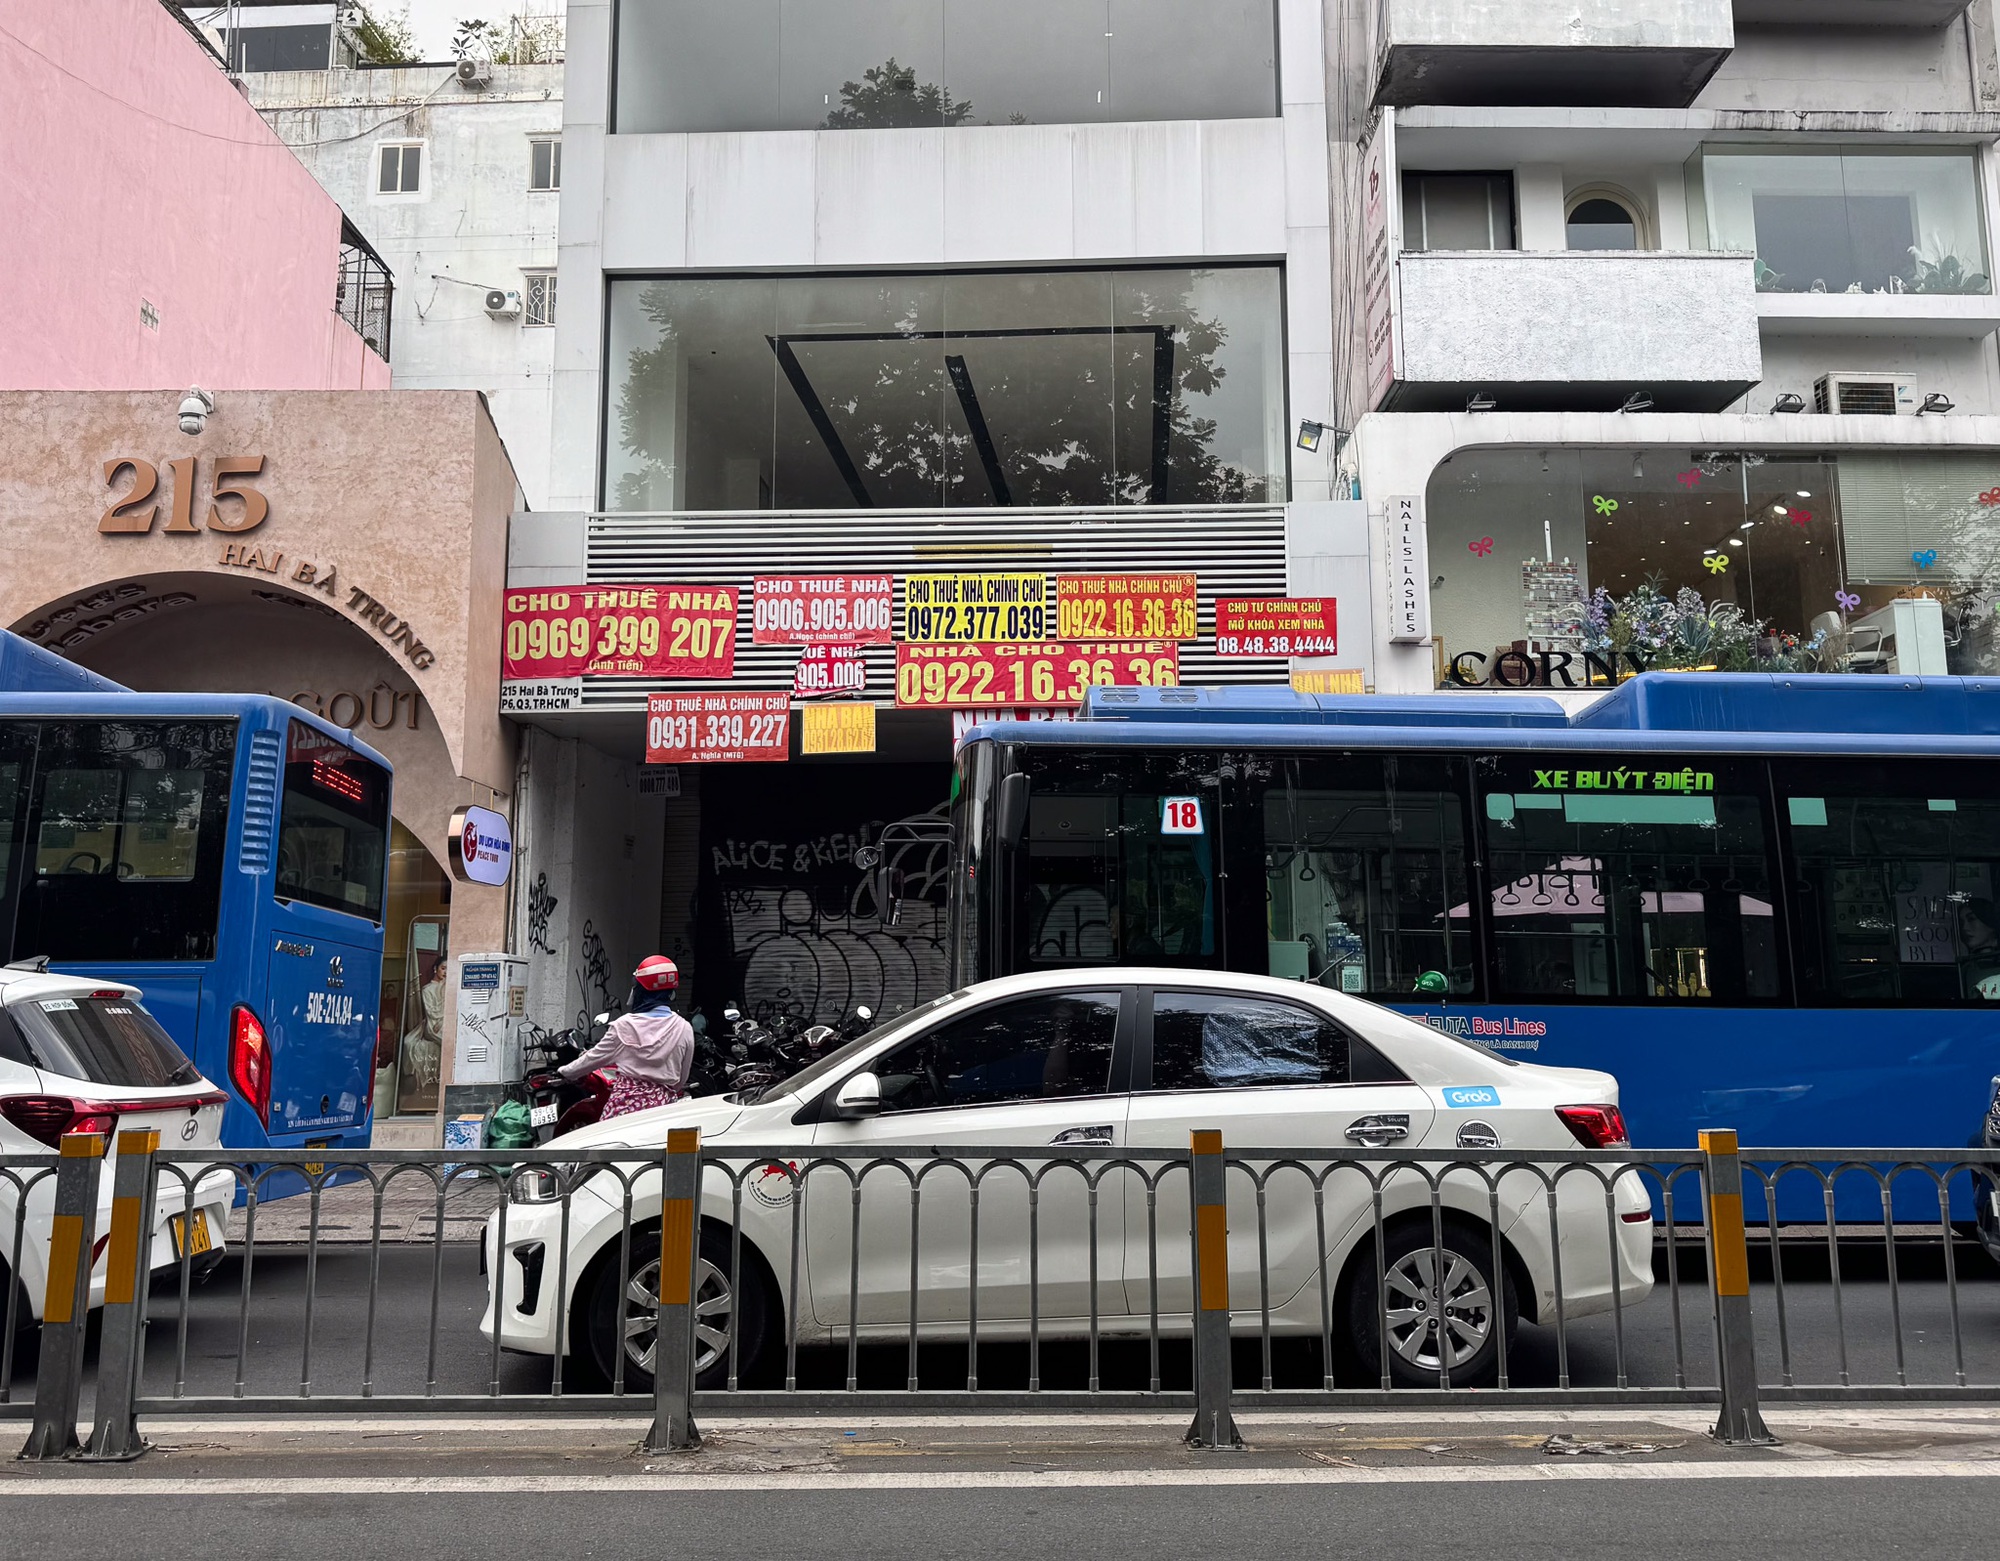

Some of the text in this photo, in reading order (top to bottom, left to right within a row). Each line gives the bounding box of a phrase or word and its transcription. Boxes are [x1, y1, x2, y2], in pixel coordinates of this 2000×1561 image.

[97, 455, 269, 536] 215
[756, 576, 890, 594] CHO THUÊ NHÀ
[909, 576, 1043, 602] CHO THUÊ NHÀ CHÍNH CHỦ
[1059, 580, 1078, 595] CHO
[1081, 576, 1106, 595] THUÊ
[1109, 576, 1129, 594] NHÀ
[1131, 576, 1159, 594] CHÍNH
[219, 543, 283, 575] HAI
[291, 559, 337, 597] BÀ
[346, 585, 436, 670] TRƯNG
[508, 587, 734, 613] CHO THUÊ NHÀ
[1267, 601, 1298, 613] CHÍNH
[1301, 599, 1322, 612] CHỦ
[755, 598, 890, 631] 0906.905.006
[908, 605, 1043, 640] 0972.377.039
[1060, 598, 1195, 639] 0922.16.36.36
[1228, 617, 1324, 630] MỞ KHÓA XEM NHÀ
[507, 615, 733, 660] 0969 399 207
[910, 641, 1164, 658] NHÀ CHO THUÊ
[1218, 636, 1335, 653] 08.48.38.4444
[803, 645, 826, 659] UÊ
[589, 660, 614, 671] (Anh
[1450, 651, 1658, 688] CORNY
[502, 686, 516, 696] 215
[537, 686, 548, 695] Bà
[551, 686, 579, 698] Trưng
[900, 658, 1175, 703] 0922.16.3636
[651, 700, 672, 711] CHO
[676, 696, 702, 711] THUÊ
[705, 696, 728, 711] NHÀ
[730, 695, 767, 710] CHÍNH
[770, 694, 787, 709] CHỦ
[649, 714, 787, 749] 0931.339.227
[723, 751, 744, 759] (MTG)
[1533, 770, 1568, 788] XE
[1576, 766, 1647, 789] BUÝT
[1166, 801, 1197, 829] 18
[793, 845, 812, 873] &
[307, 992, 352, 1025] 50E-214.84
[1473, 1017, 1502, 1035] Bus
[1504, 1017, 1546, 1036] Lines
[1452, 1091, 1492, 1103] Grab
